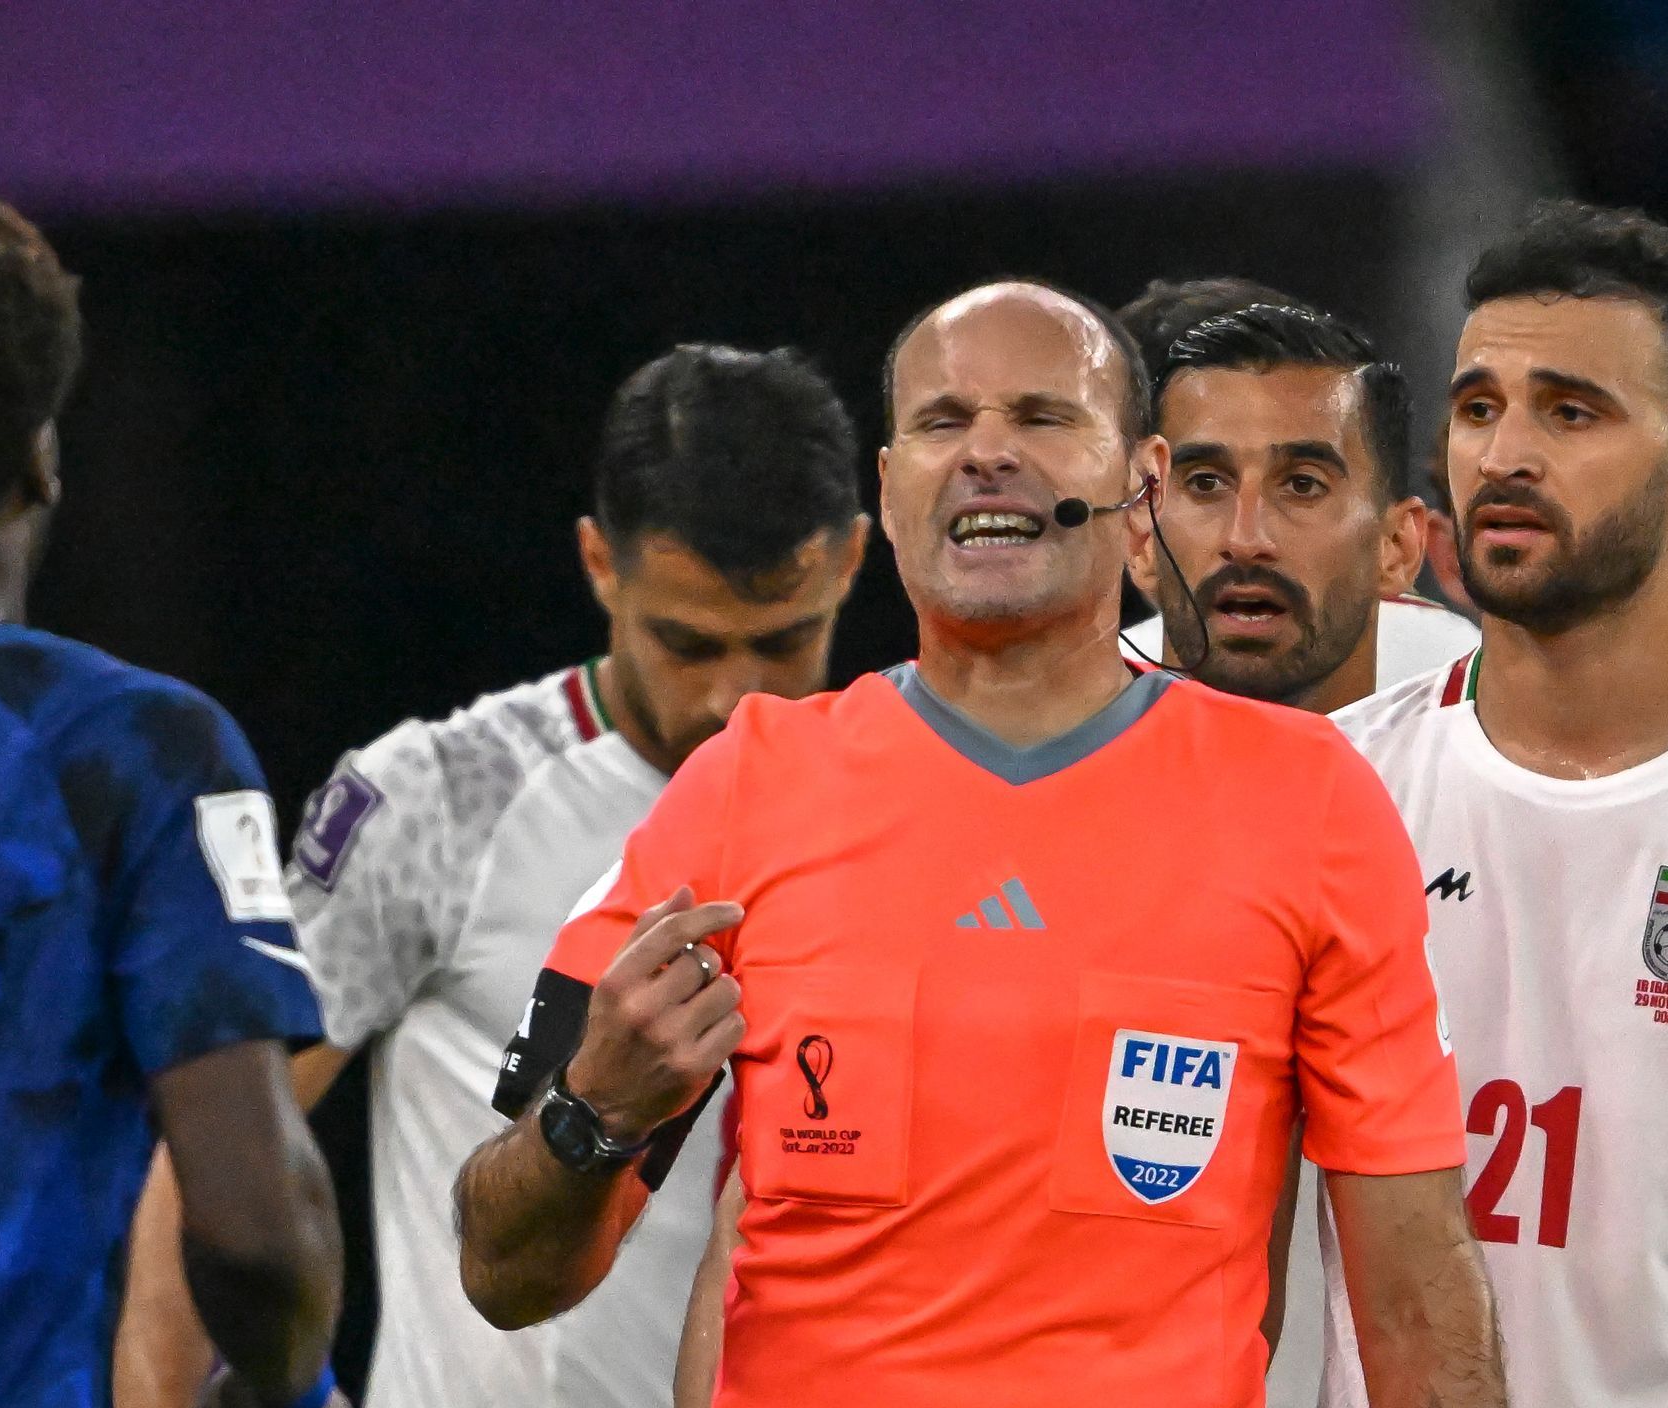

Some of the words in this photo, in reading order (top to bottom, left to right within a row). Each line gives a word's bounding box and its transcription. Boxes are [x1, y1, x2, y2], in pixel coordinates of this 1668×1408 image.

[1635, 993, 1649, 1007] 29
[1121, 1038, 1221, 1090] FIFA
[797, 1129, 837, 1140] WORLD
[840, 1130, 862, 1140] CUP
[1113, 1105, 1214, 1137] REFEREE
[1131, 1164, 1180, 1188] 2022
[1466, 1079, 1582, 1249] 21
